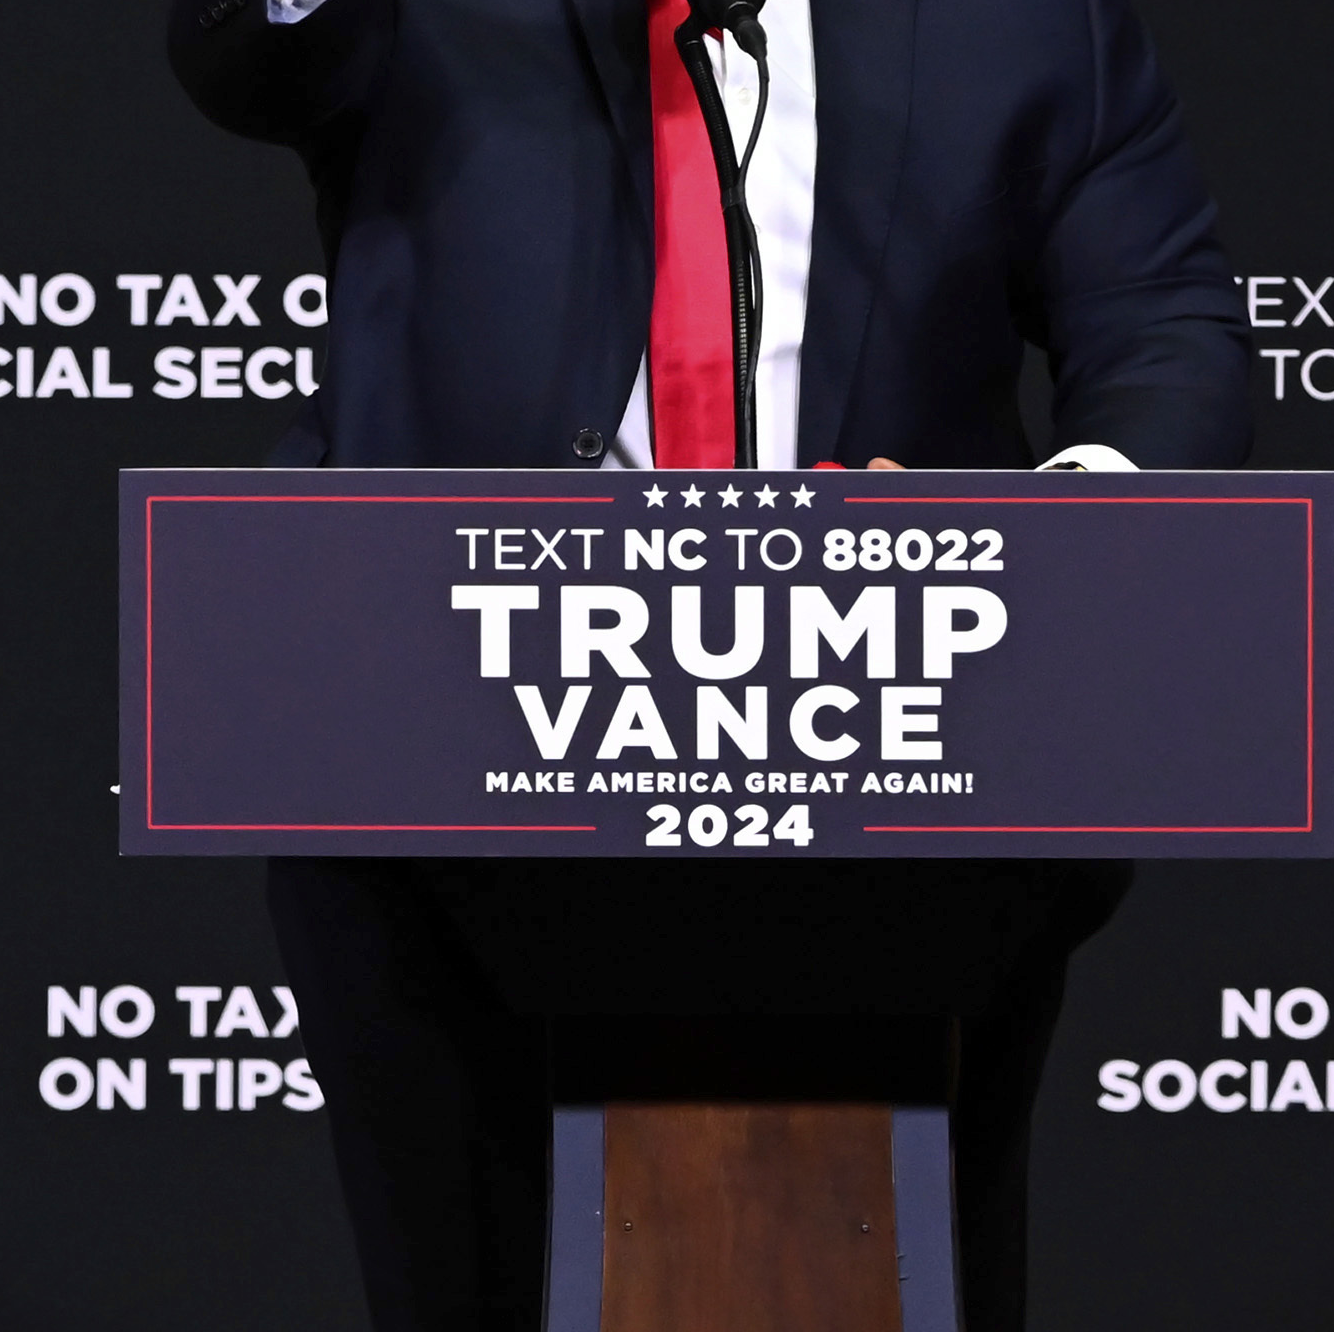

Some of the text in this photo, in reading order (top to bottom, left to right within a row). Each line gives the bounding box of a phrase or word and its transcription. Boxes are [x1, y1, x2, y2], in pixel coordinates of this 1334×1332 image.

[117, 273, 261, 327] TAX
[455, 528, 1005, 572] TEXT NC TO 88022
[451, 585, 1008, 680] TRUMP
[513, 684, 943, 762] VANCE
[485, 771, 974, 795] MAKE AMERICA GREAT AGAIN!
[645, 803, 814, 848] 2024
[48, 985, 300, 1038] NO TAX
[1222, 988, 1329, 1040] NO
[39, 1058, 325, 1111] ON TIPS
